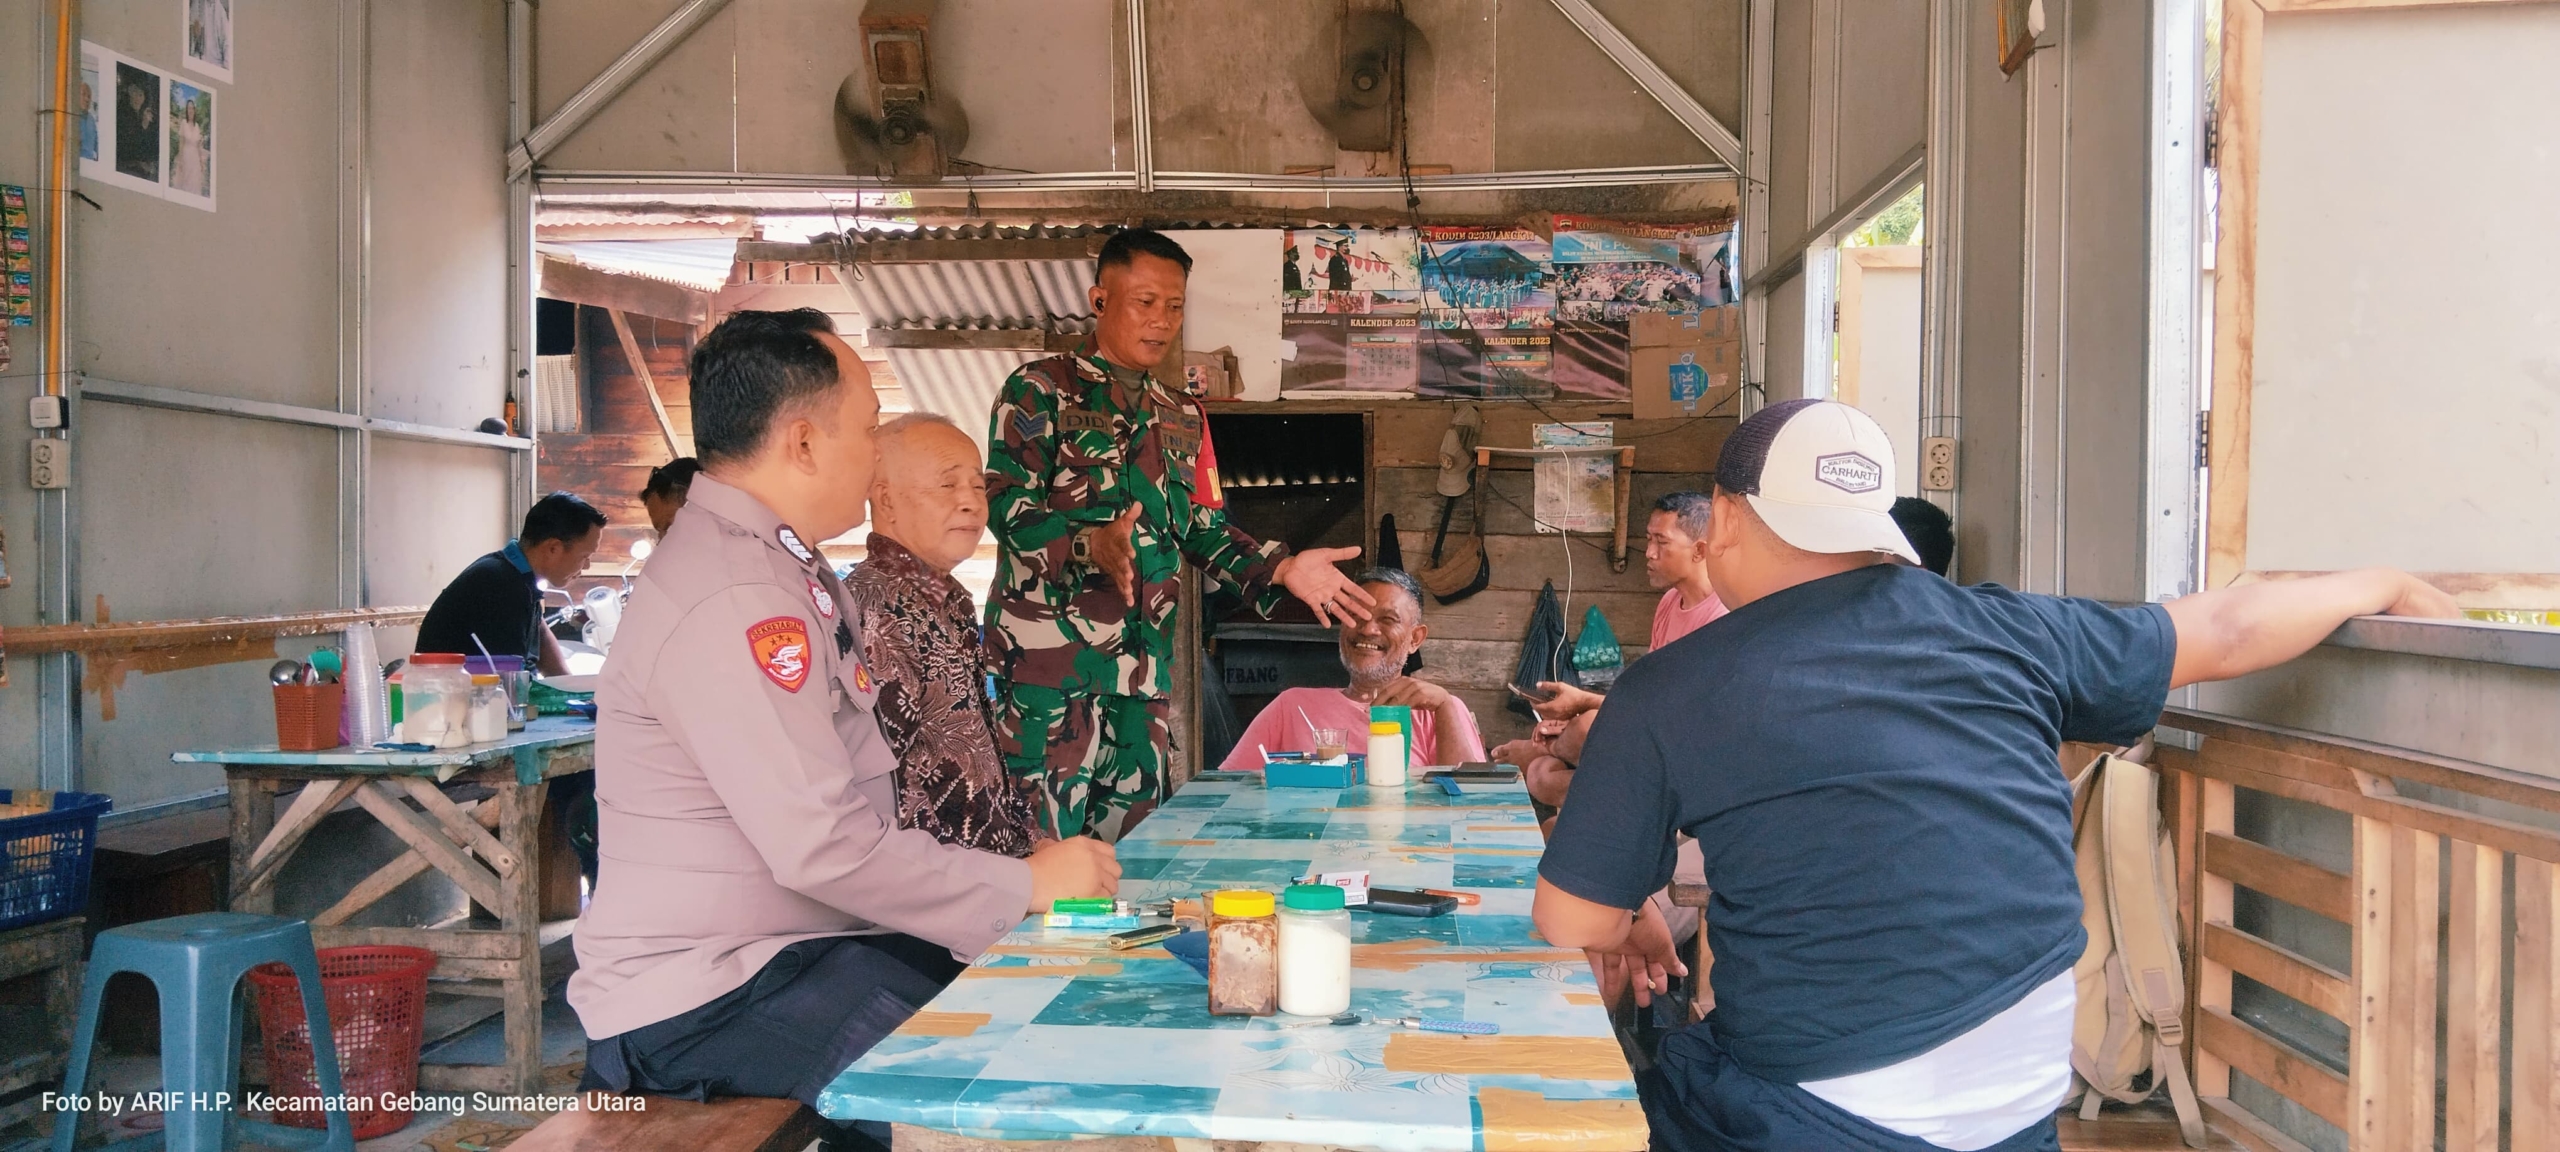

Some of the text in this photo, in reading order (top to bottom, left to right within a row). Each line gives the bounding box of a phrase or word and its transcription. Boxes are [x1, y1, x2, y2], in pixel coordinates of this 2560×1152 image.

[1435, 231, 1466, 240] KODIM
[1350, 318, 1416, 327] KALENDER 2023
[1484, 336, 1551, 345] KALENDER 2023
[1680, 352, 1697, 412] LINK-Q
[1163, 434, 1183, 450] TNI
[1821, 465, 1879, 482] CARHARTT
[751, 621, 802, 638] SEKRETARIAT
